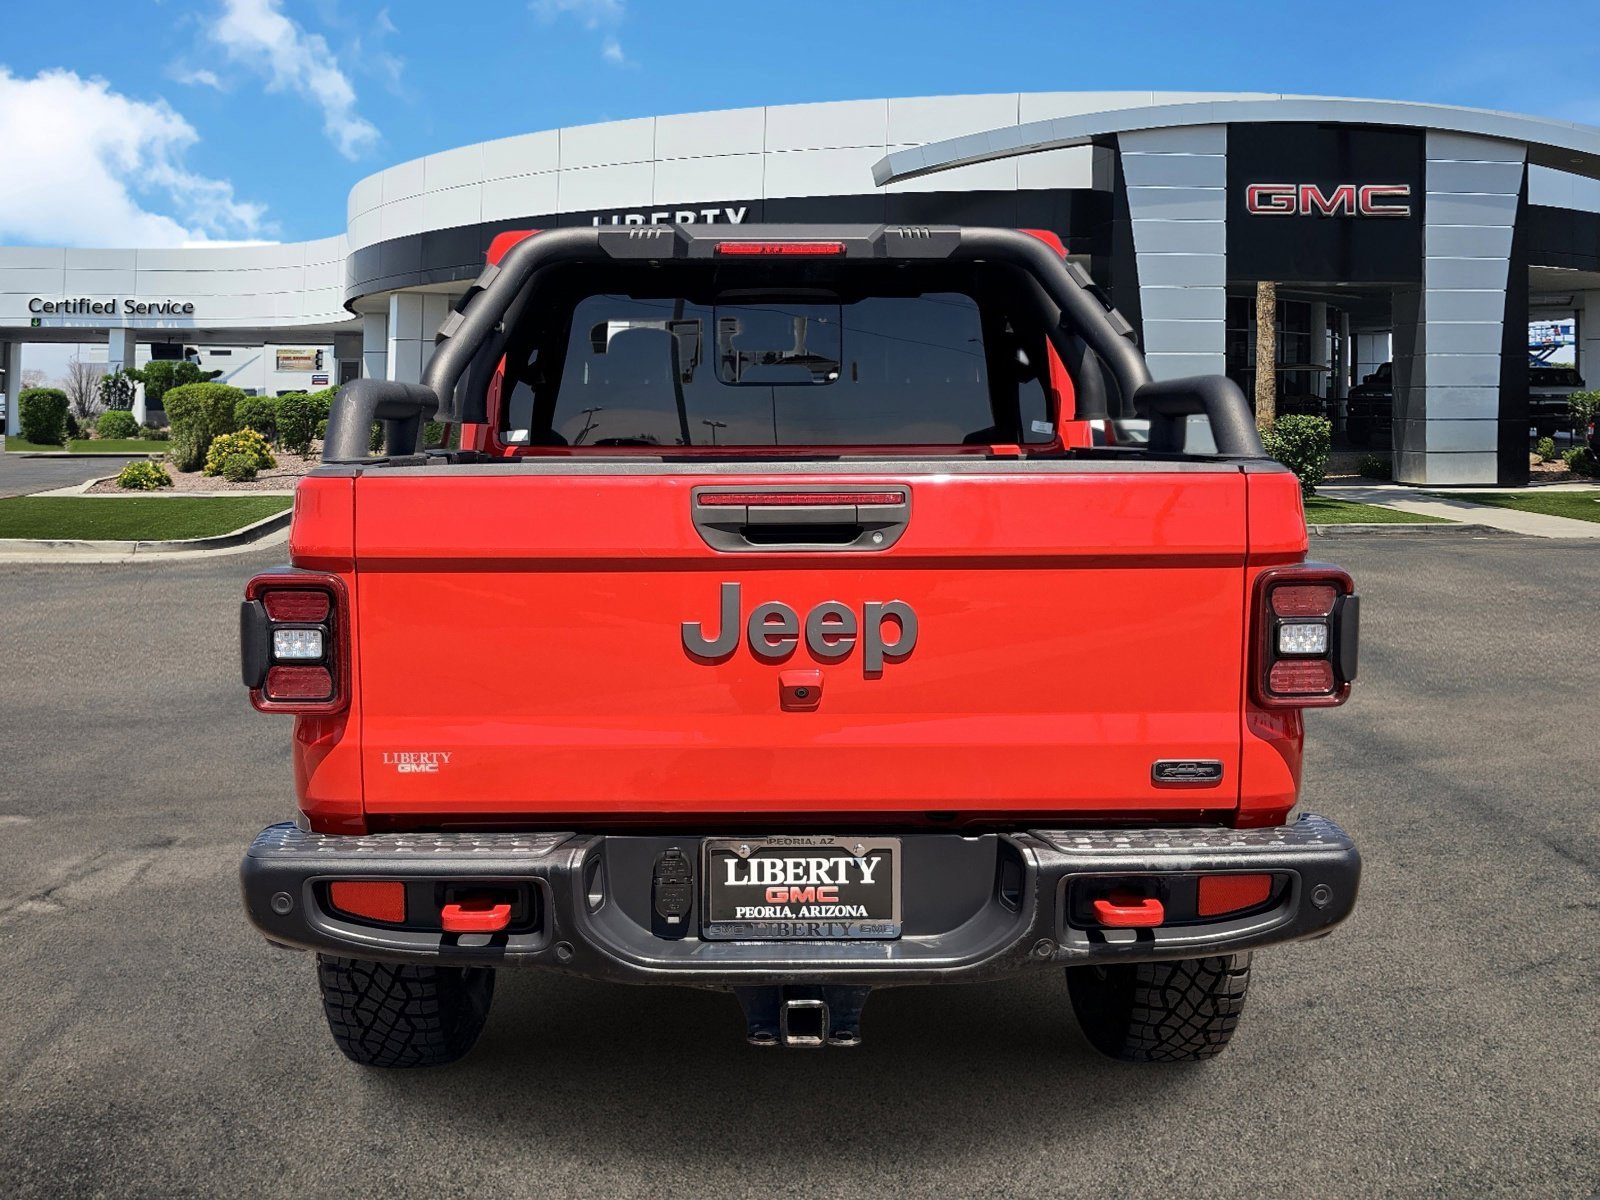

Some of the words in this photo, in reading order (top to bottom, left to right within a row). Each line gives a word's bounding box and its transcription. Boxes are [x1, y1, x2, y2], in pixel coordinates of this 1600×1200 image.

[1246, 184, 1411, 216] GMC
[28, 297, 116, 314] Certified
[124, 299, 194, 315] Service
[681, 582, 919, 672] Jeep
[383, 752, 452, 764] LIBERTY
[398, 764, 439, 773] GMC
[724, 857, 882, 886] LIBERTY
[766, 886, 840, 904] GMC
[736, 906, 796, 919] PEORIA,
[798, 904, 869, 918] ARIZONA
[751, 922, 854, 937] LIBERTY
